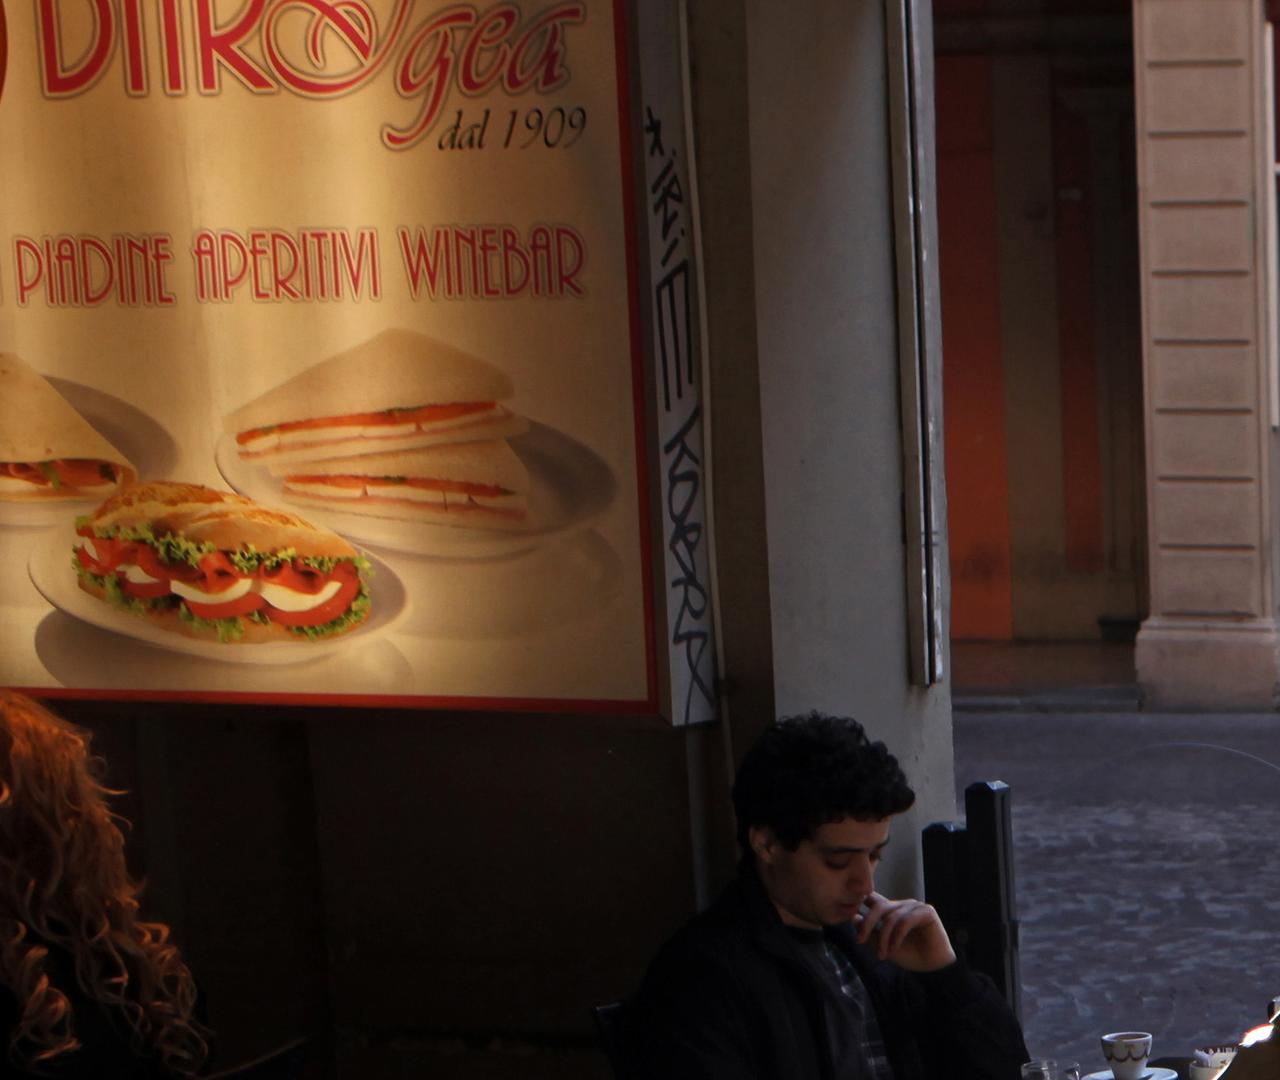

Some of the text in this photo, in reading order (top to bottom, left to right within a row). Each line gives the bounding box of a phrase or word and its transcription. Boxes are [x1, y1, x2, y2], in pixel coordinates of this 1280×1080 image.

[438, 106, 587, 150] dal 1909
[15, 226, 584, 305] PIADINE APERITIVI WINEBAR
